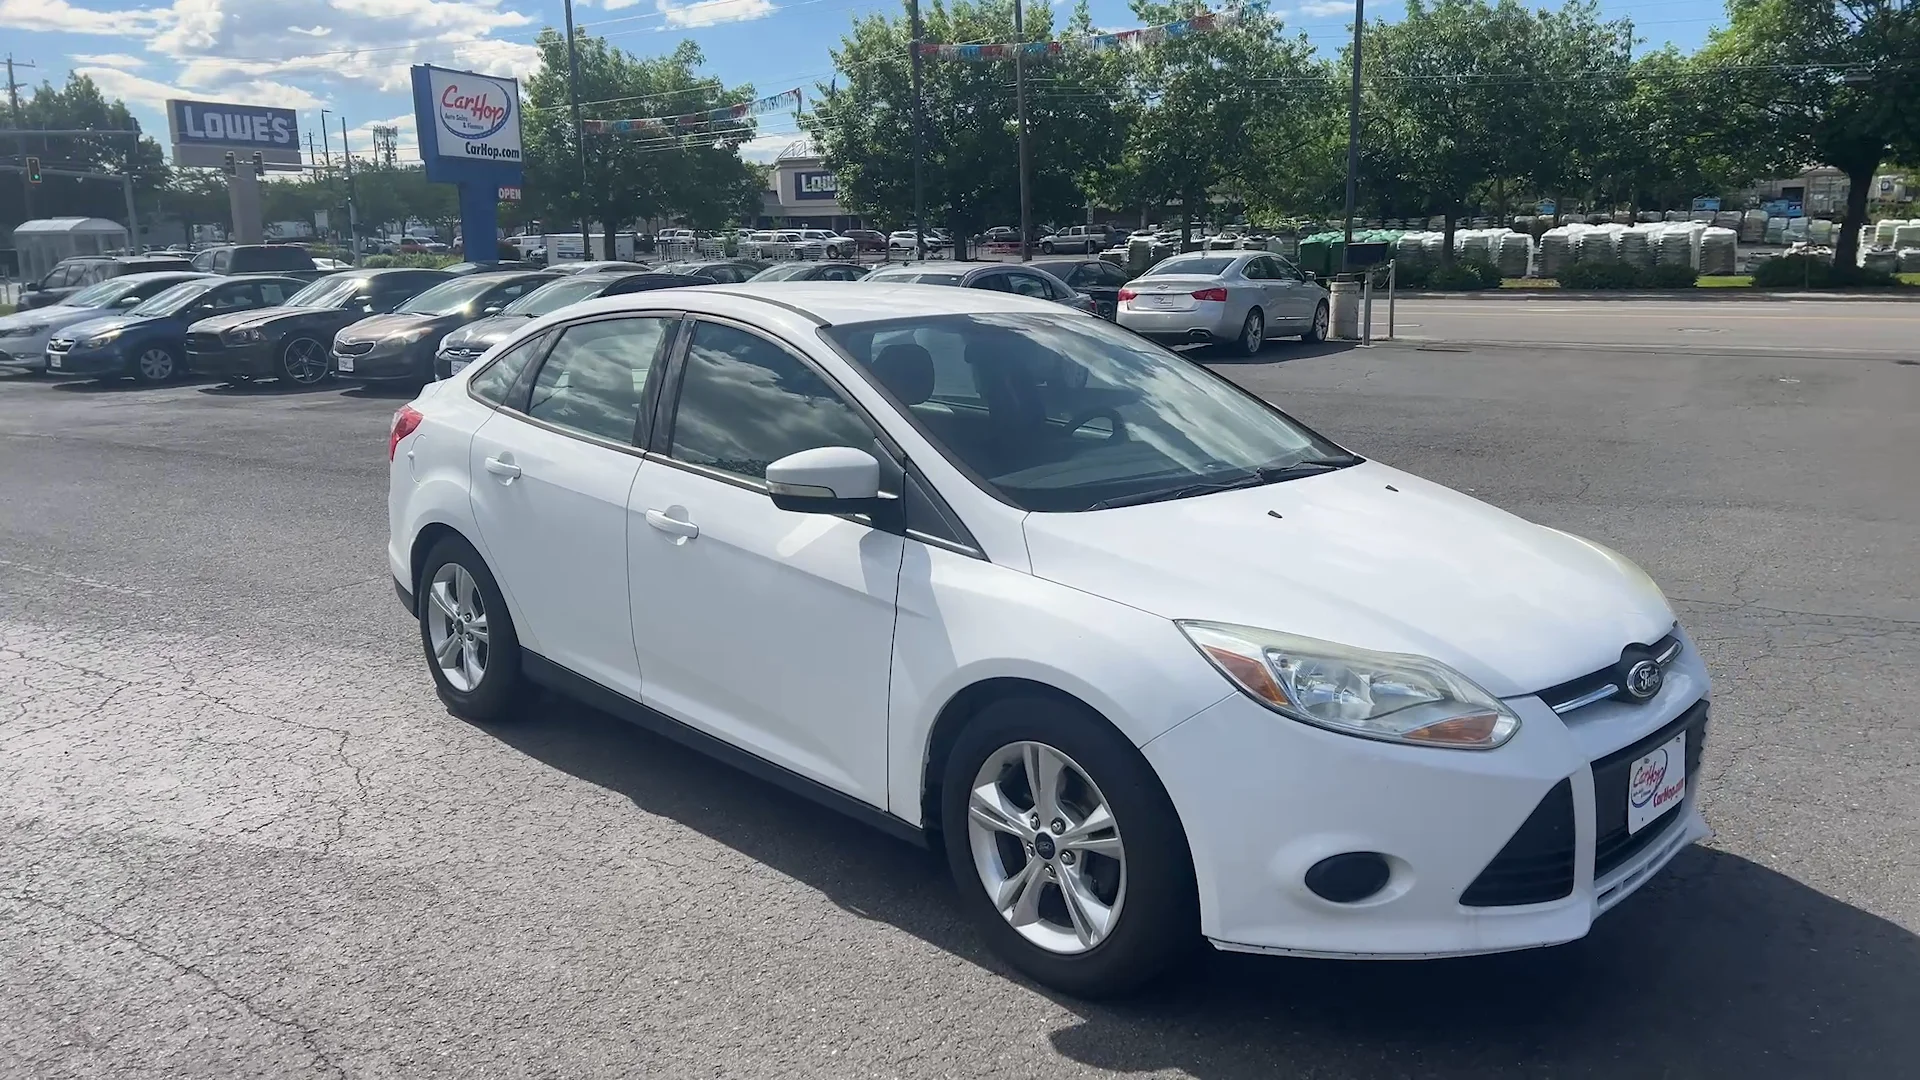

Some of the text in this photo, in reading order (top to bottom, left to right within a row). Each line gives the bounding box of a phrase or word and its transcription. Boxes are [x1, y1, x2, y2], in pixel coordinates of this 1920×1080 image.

[442, 85, 504, 127] CarHop
[184, 106, 290, 144] LOWE'S
[465, 141, 520, 159] CarHop.com
[498, 188, 521, 200] OPEN
[801, 174, 836, 192] LOW
[1639, 666, 1659, 690] Ford
[1633, 761, 1665, 788] CarHop
